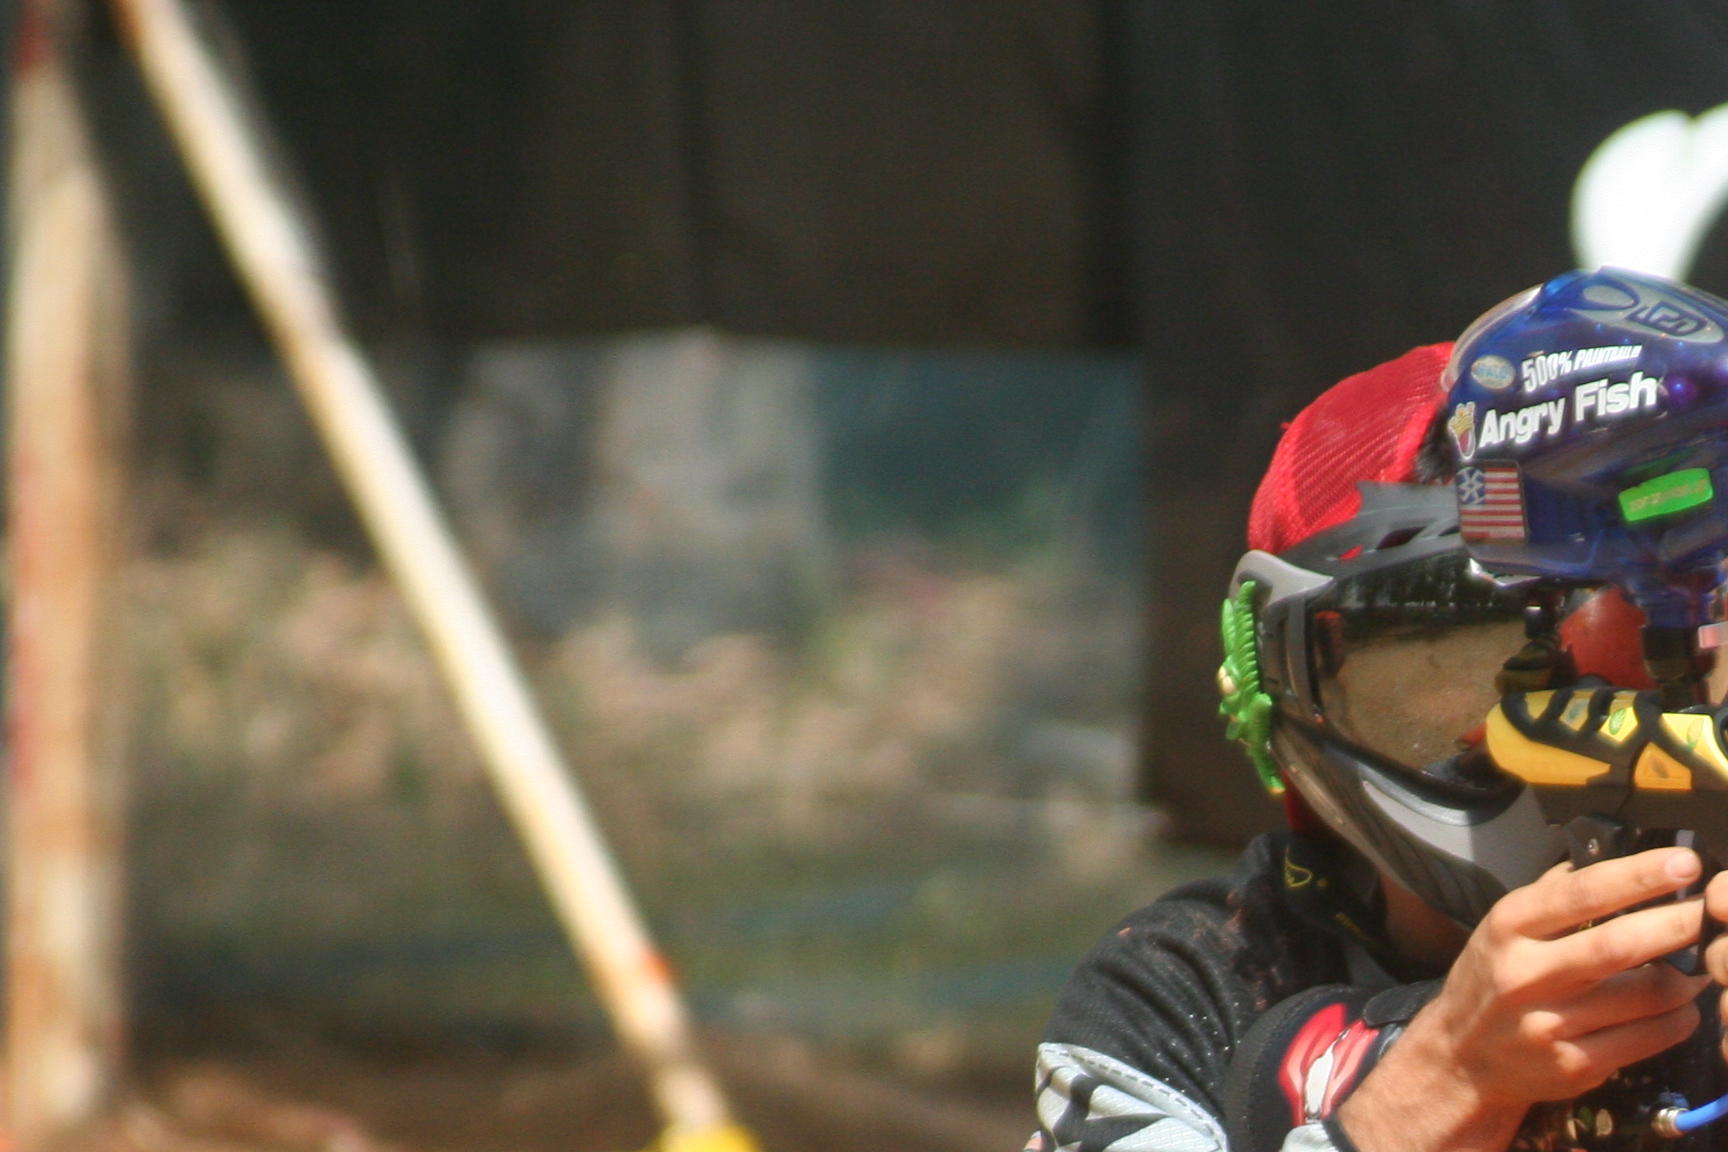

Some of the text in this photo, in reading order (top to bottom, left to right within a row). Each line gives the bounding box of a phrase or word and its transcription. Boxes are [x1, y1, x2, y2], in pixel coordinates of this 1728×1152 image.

[1520, 350, 1574, 393] 500%
[1478, 371, 1659, 450] Angry Fish
